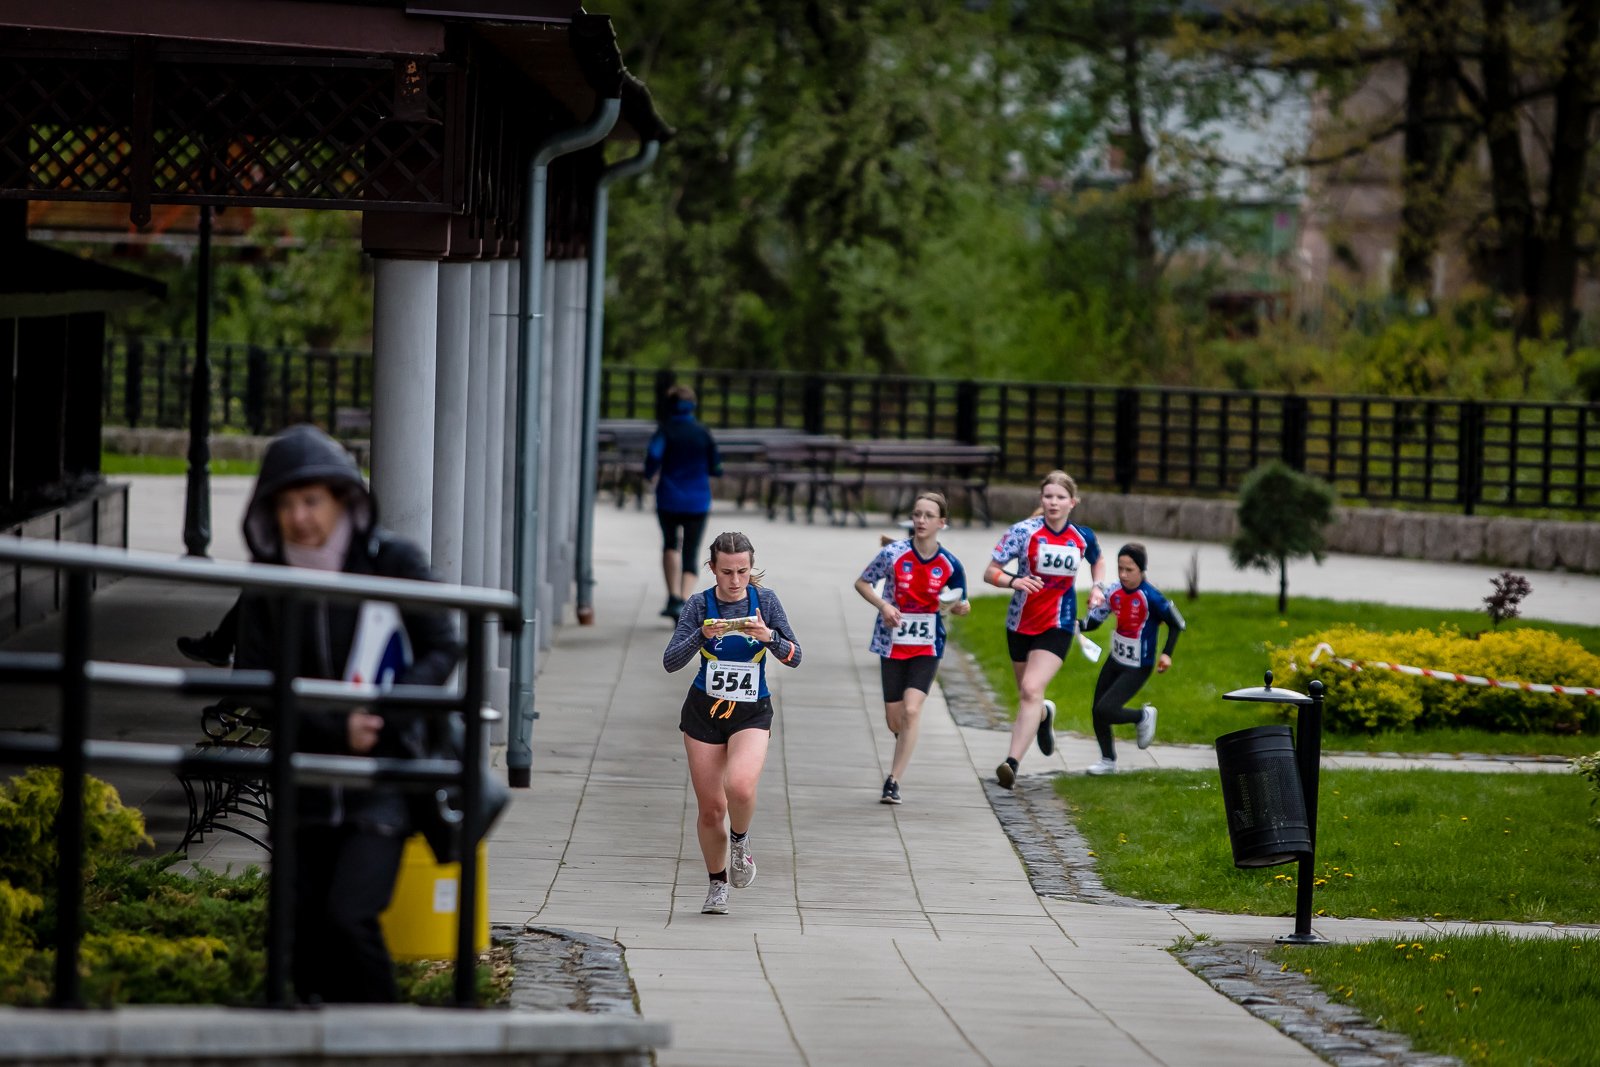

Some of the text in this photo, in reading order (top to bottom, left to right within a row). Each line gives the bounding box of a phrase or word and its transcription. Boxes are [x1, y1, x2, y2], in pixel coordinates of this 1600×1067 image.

[1043, 553, 1073, 569] 360
[897, 621, 929, 638] 345
[711, 670, 752, 692] 554
